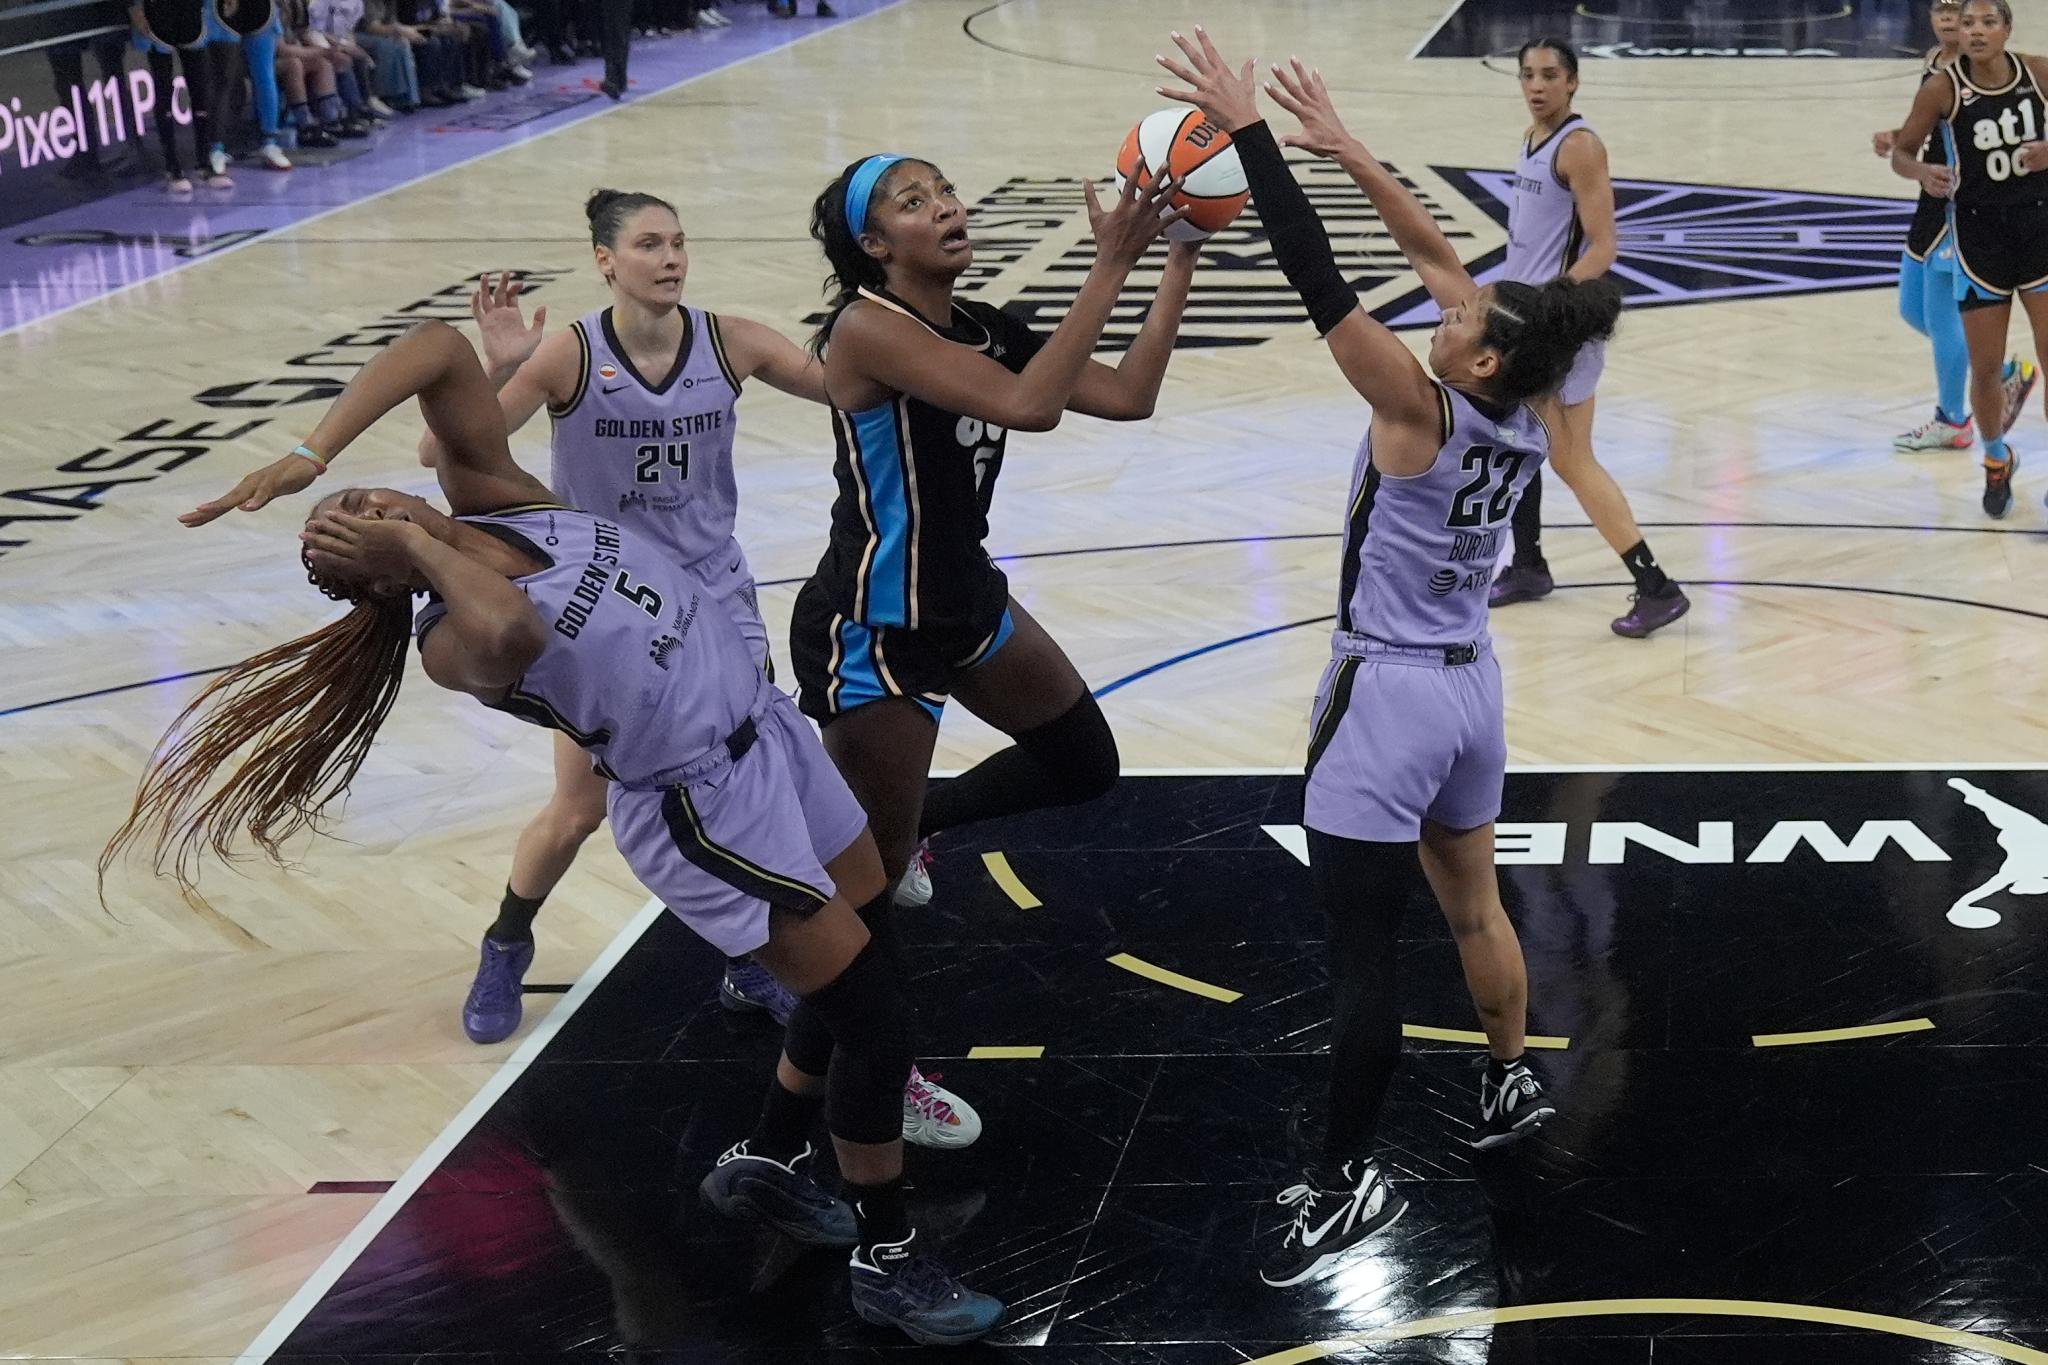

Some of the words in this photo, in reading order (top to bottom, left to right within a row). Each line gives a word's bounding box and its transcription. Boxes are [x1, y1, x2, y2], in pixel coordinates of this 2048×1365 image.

[0, 84, 88, 175] Pixel
[88, 76, 126, 146] 11
[129, 69, 193, 125] Po
[595, 418, 665, 438] GOLDEN
[673, 410, 722, 437] STATE
[635, 441, 690, 485] 24
[1445, 444, 1528, 529] 22
[1448, 529, 1500, 561] BURTON
[554, 562, 610, 640] GOLDEN
[593, 519, 620, 567] STATE
[612, 568, 664, 620] 5
